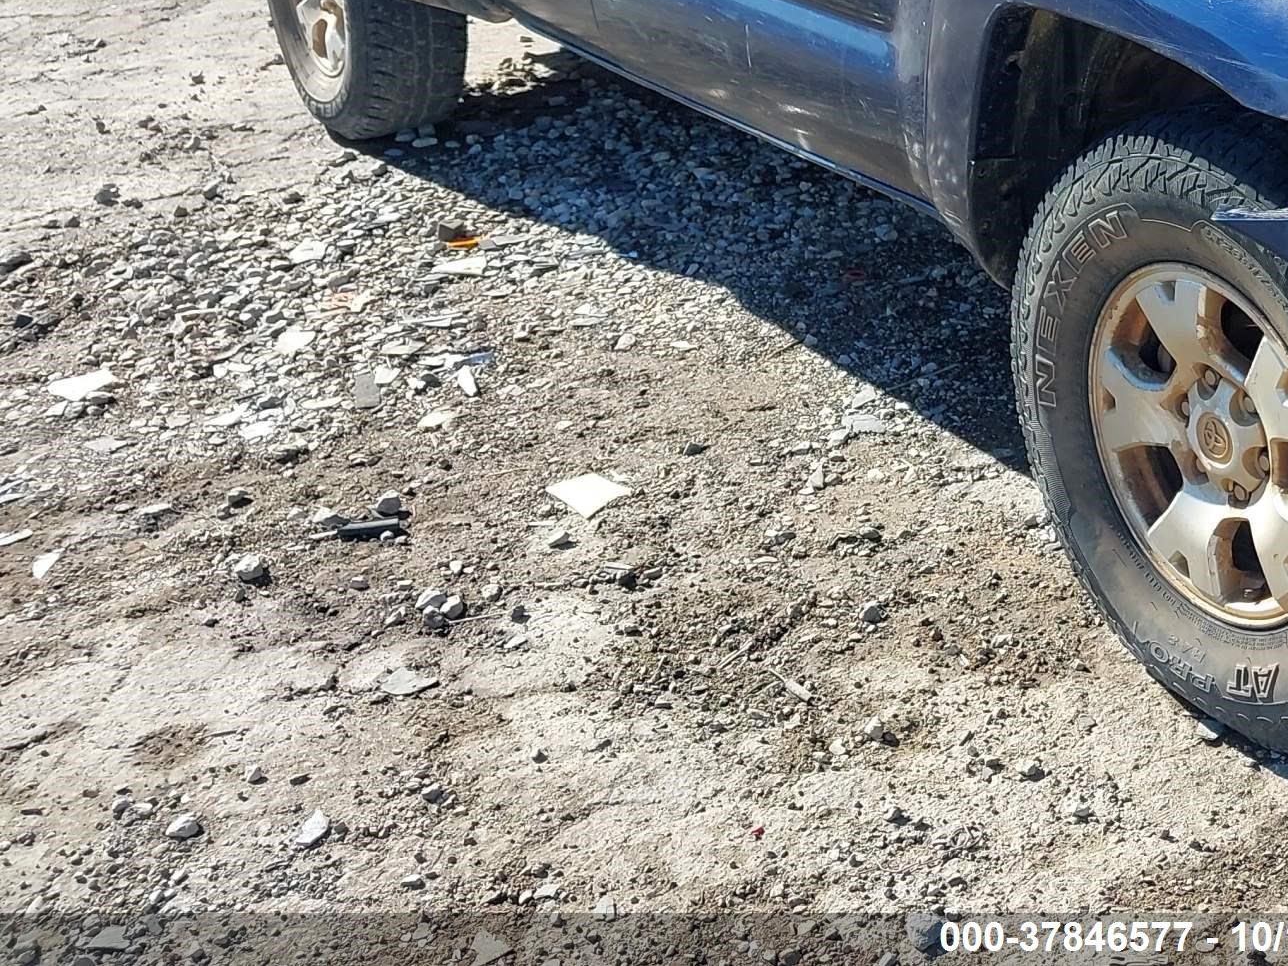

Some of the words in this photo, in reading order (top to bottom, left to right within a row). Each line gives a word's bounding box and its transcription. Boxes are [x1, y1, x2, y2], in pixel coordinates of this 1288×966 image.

[1035, 210, 1128, 408] NEXEN
[1149, 640, 1216, 693] PRO
[1226, 662, 1280, 702] AT
